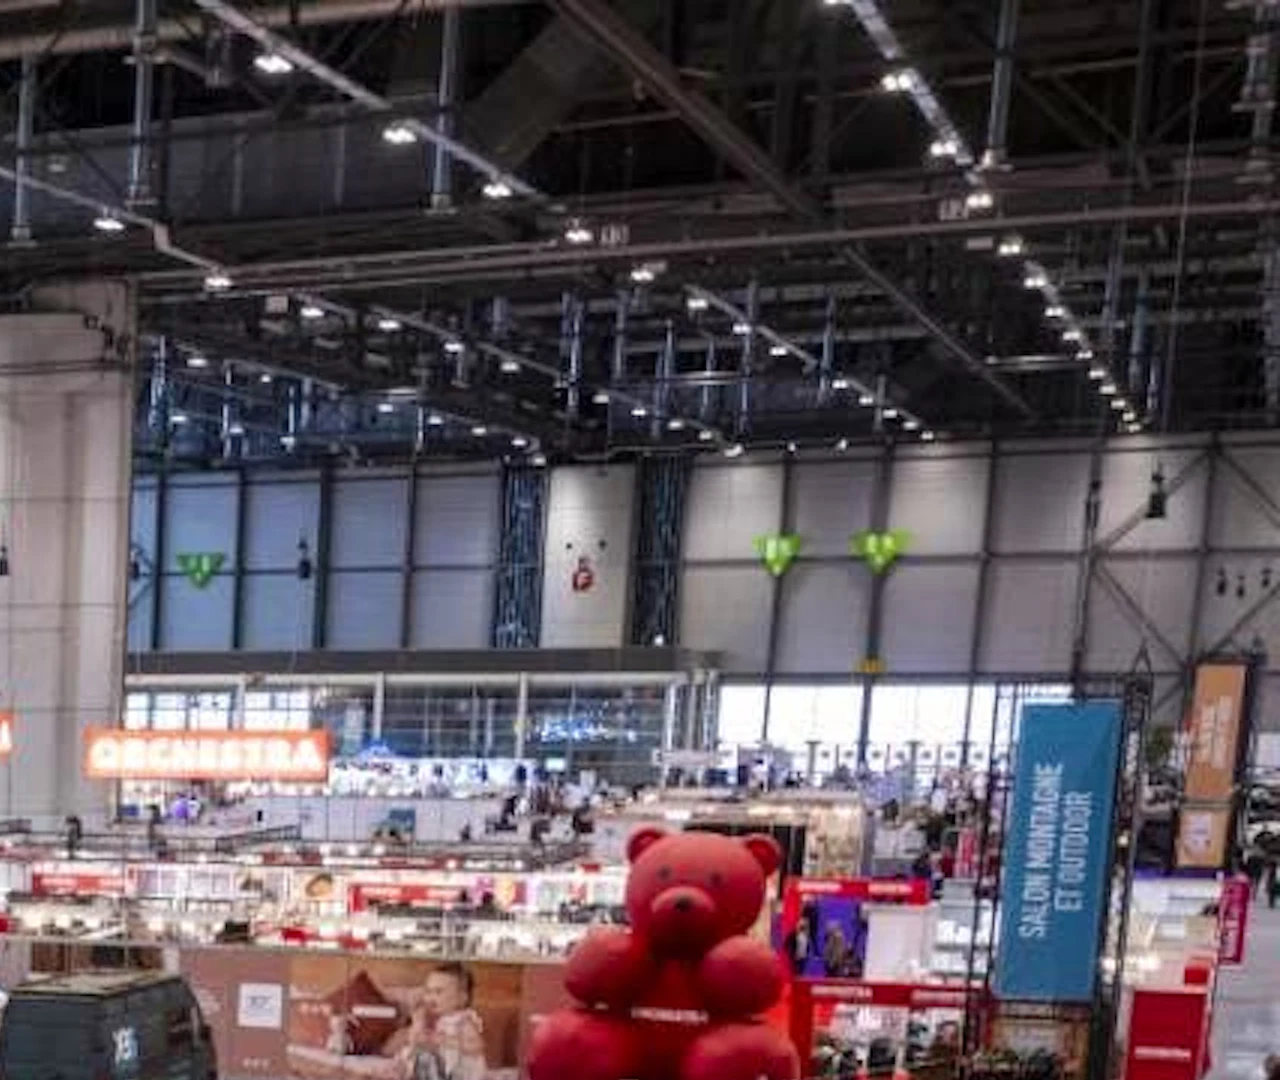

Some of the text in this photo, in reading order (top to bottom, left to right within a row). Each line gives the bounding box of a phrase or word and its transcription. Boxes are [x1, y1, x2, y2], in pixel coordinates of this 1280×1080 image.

[1018, 760, 1064, 940] SALON MONTAGNE
[1054, 789, 1093, 913] ET OUTDOOR
